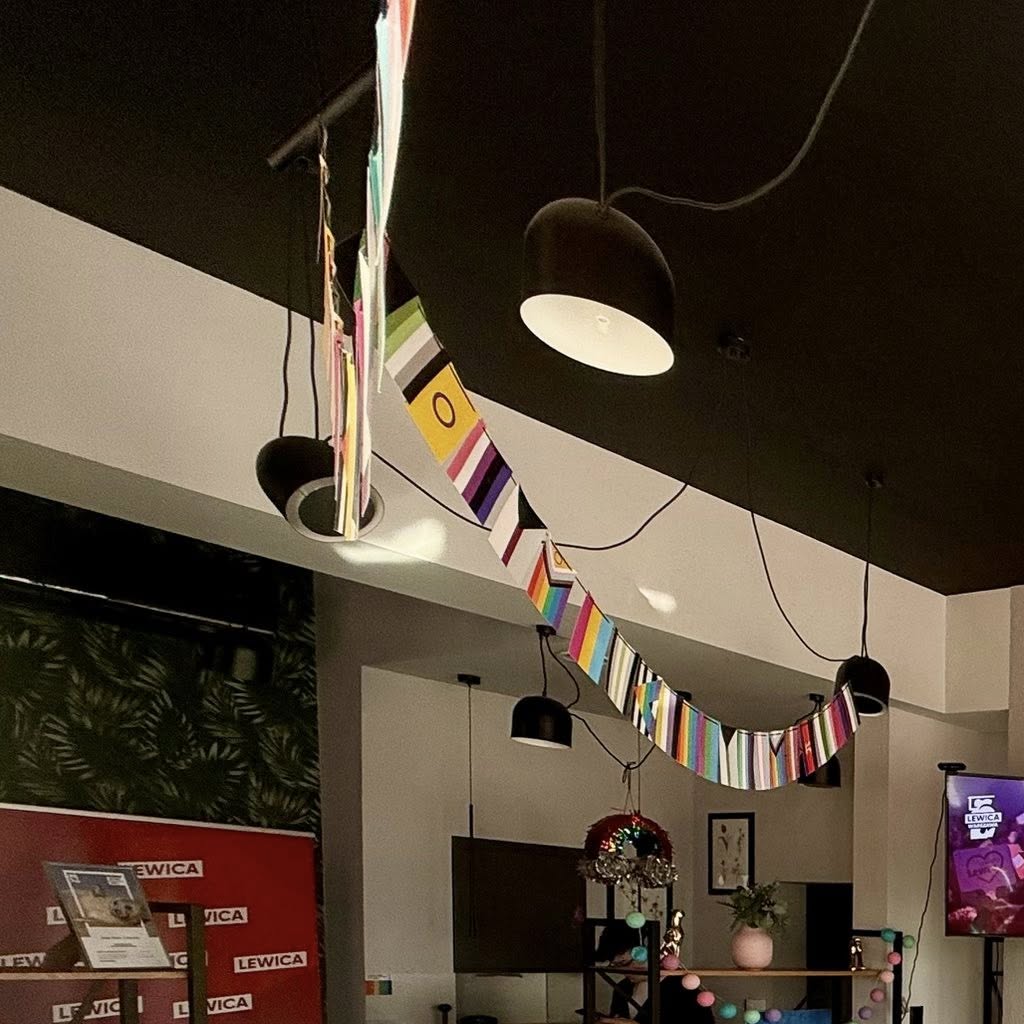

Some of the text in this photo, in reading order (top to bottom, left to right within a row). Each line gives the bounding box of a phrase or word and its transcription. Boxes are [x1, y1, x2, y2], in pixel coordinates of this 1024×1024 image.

[967, 814, 1000, 822] LEWICA
[136, 863, 199, 875] EWICA
[239, 954, 304, 970] LEWICA
